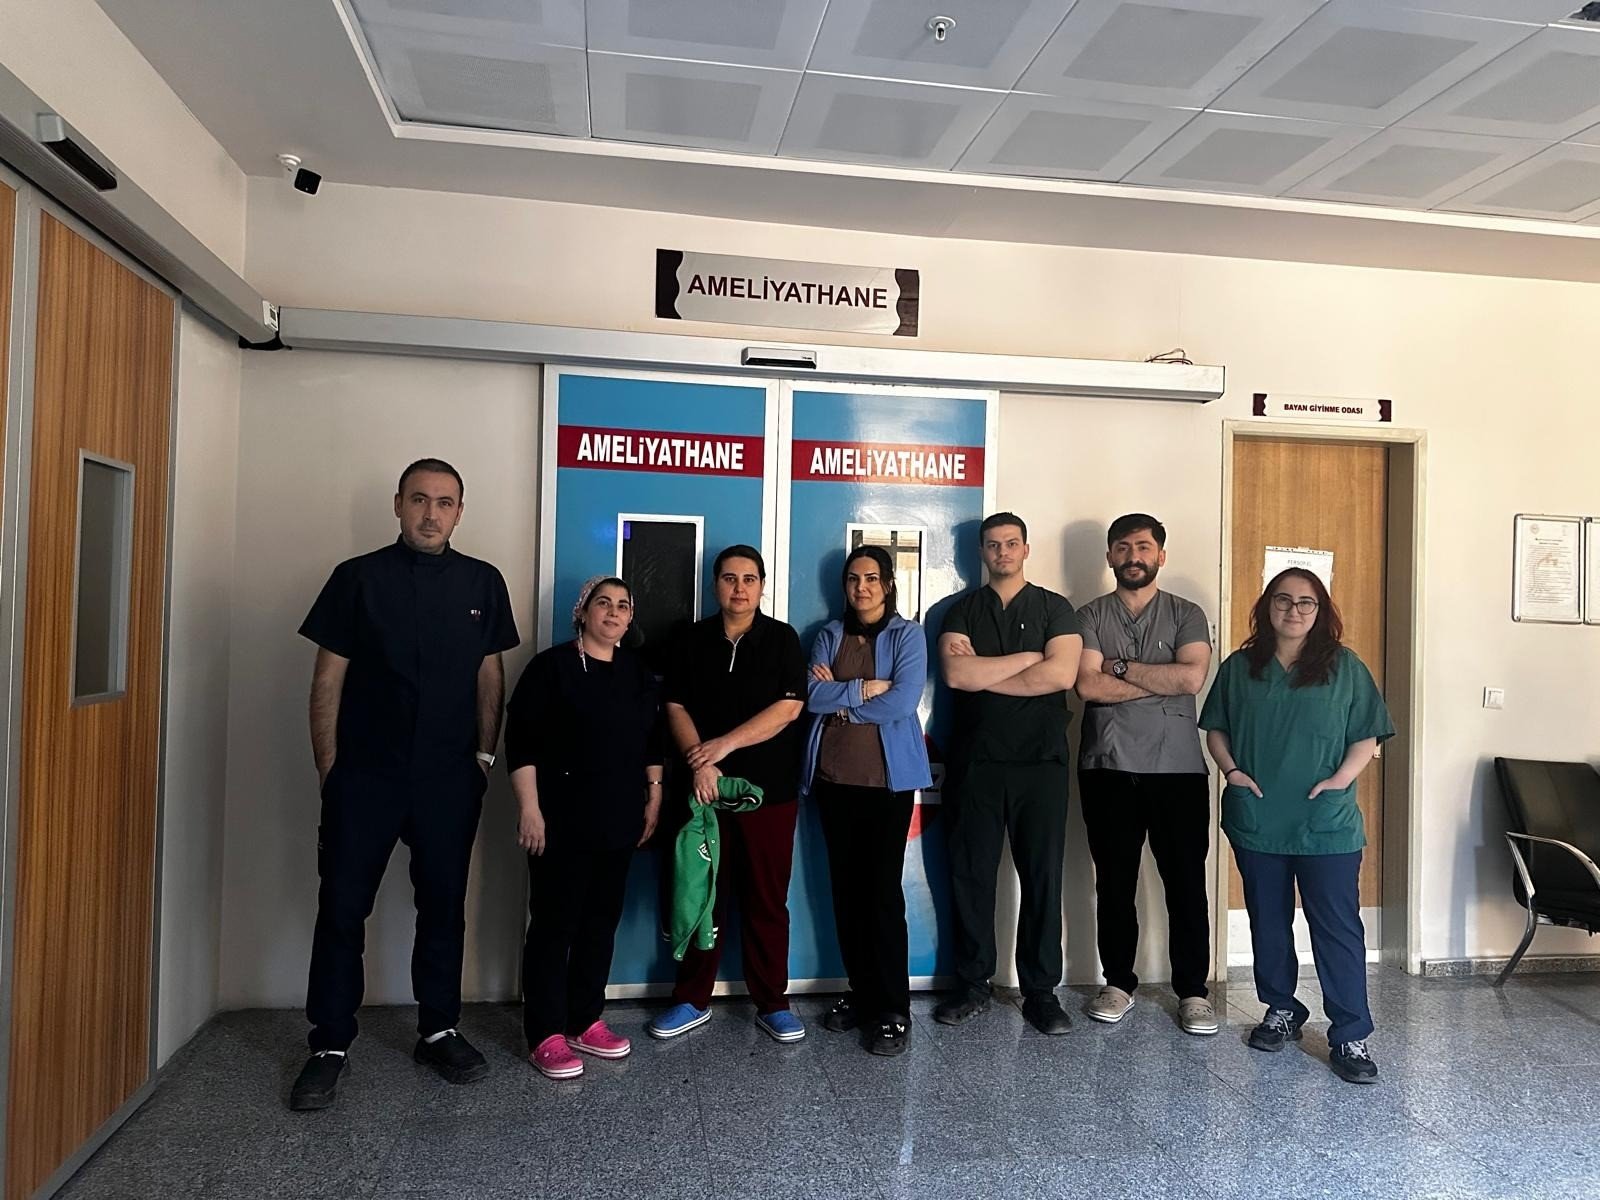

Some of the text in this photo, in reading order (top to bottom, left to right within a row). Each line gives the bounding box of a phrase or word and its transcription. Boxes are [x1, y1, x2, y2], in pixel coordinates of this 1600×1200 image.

[687, 274, 888, 309] AMELİYATHANE
[1284, 404, 1363, 414] BAYAN GİYİNME ODASI
